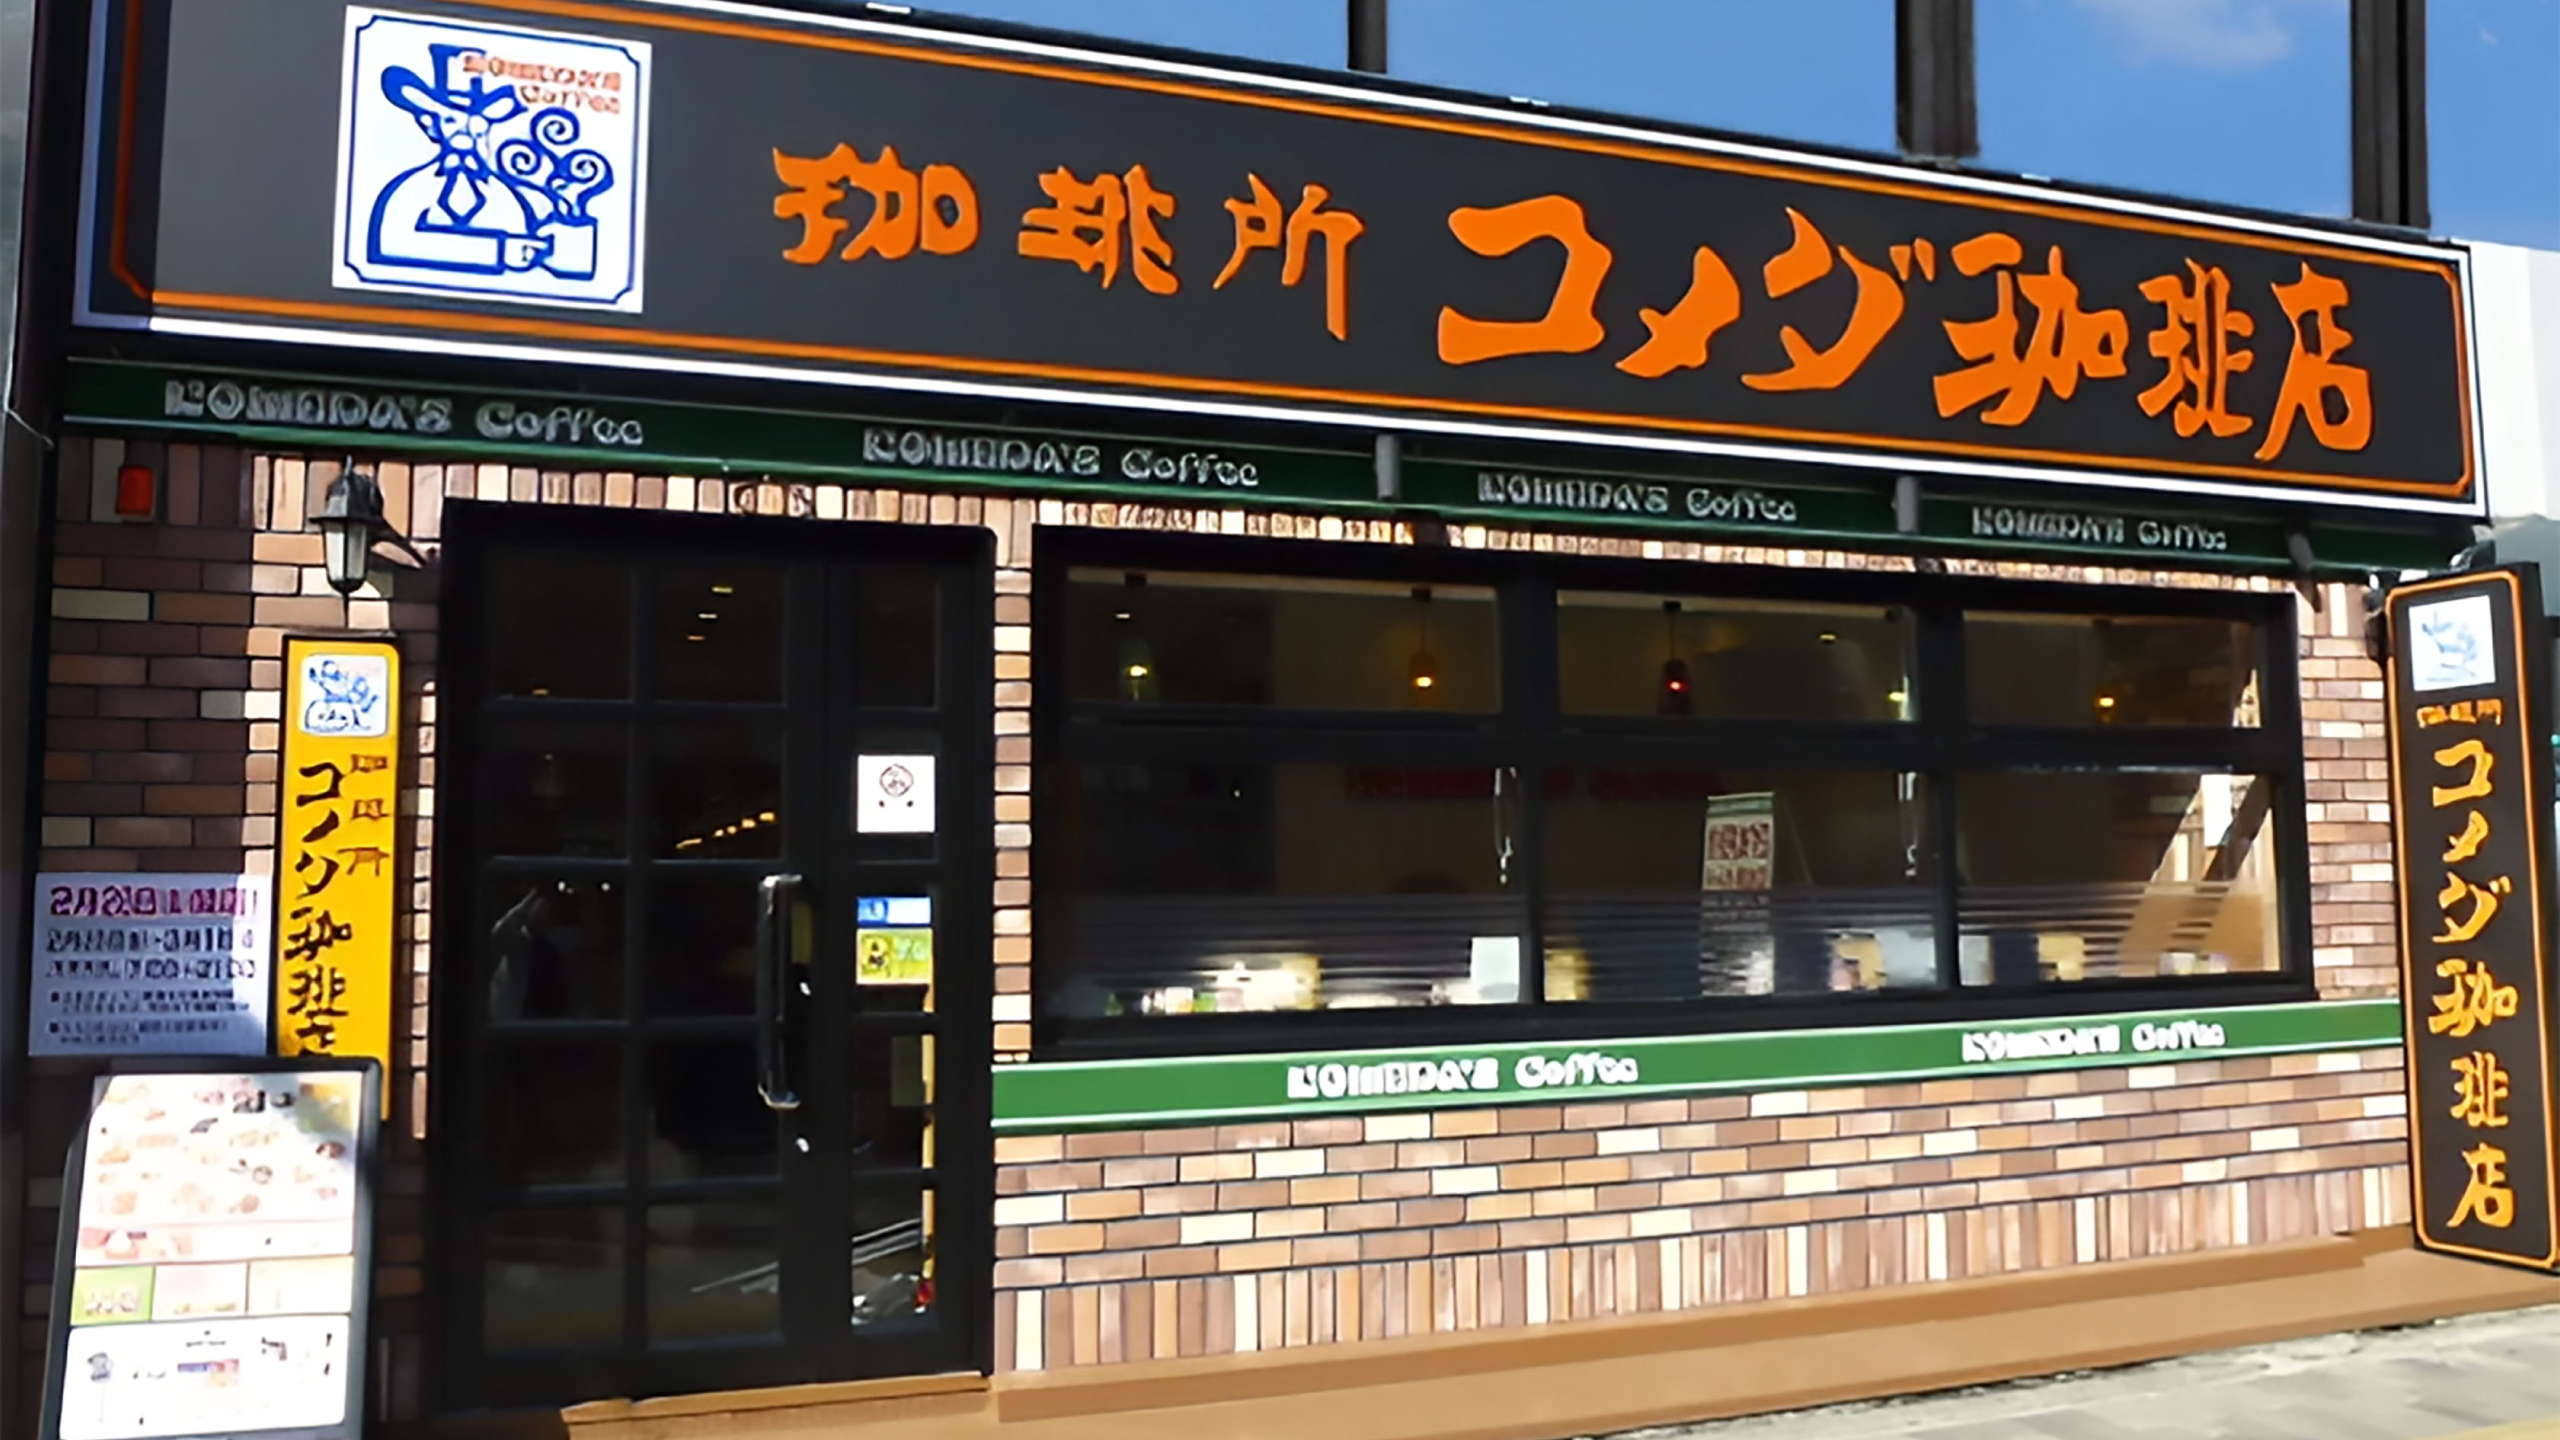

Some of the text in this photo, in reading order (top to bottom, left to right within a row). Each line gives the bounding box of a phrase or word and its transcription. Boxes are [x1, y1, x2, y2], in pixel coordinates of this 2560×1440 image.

[773, 143, 2372, 461] 珈琲所 コメダ珈琲店
[476, 402, 644, 446] Coffee
[1120, 448, 1260, 487] Coffee
[2430, 739, 2517, 1229] コメダ珈琲店
